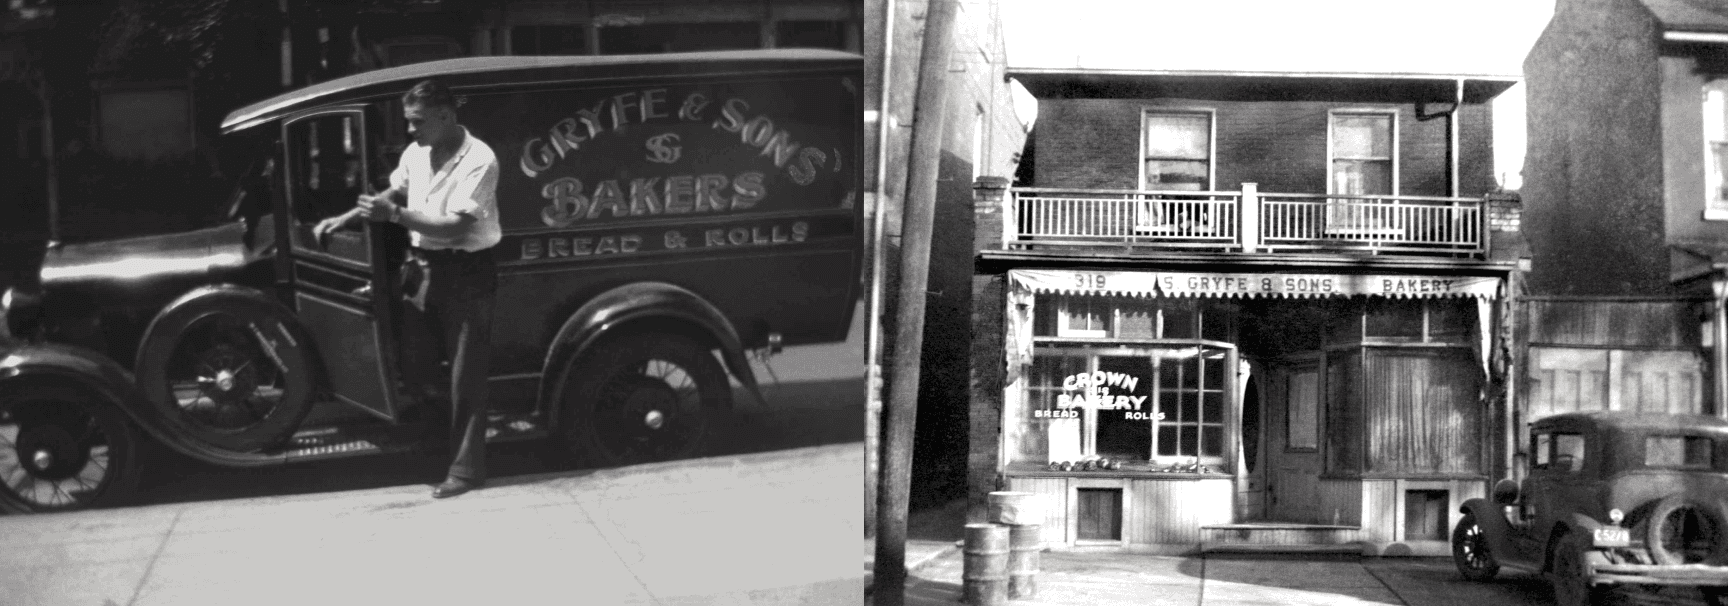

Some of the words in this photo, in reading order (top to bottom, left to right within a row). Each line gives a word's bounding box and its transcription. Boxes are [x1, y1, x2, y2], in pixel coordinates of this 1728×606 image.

[520, 88, 669, 178] GRYFE
[678, 92, 711, 122] &
[541, 171, 767, 228] BAKERS
[521, 234, 643, 260] BREAD
[664, 230, 687, 249] &
[705, 221, 809, 247] ROLLS
[1074, 273, 1107, 289] 319
[1187, 276, 1248, 291] GRYFE
[1261, 277, 1273, 292] &
[1382, 279, 1455, 292] BAKERY
[1063, 370, 1139, 393] CROWN
[1056, 394, 1148, 411] BAKERY
[1034, 409, 1079, 418] BREAD
[1125, 411, 1166, 420] ROLLS
